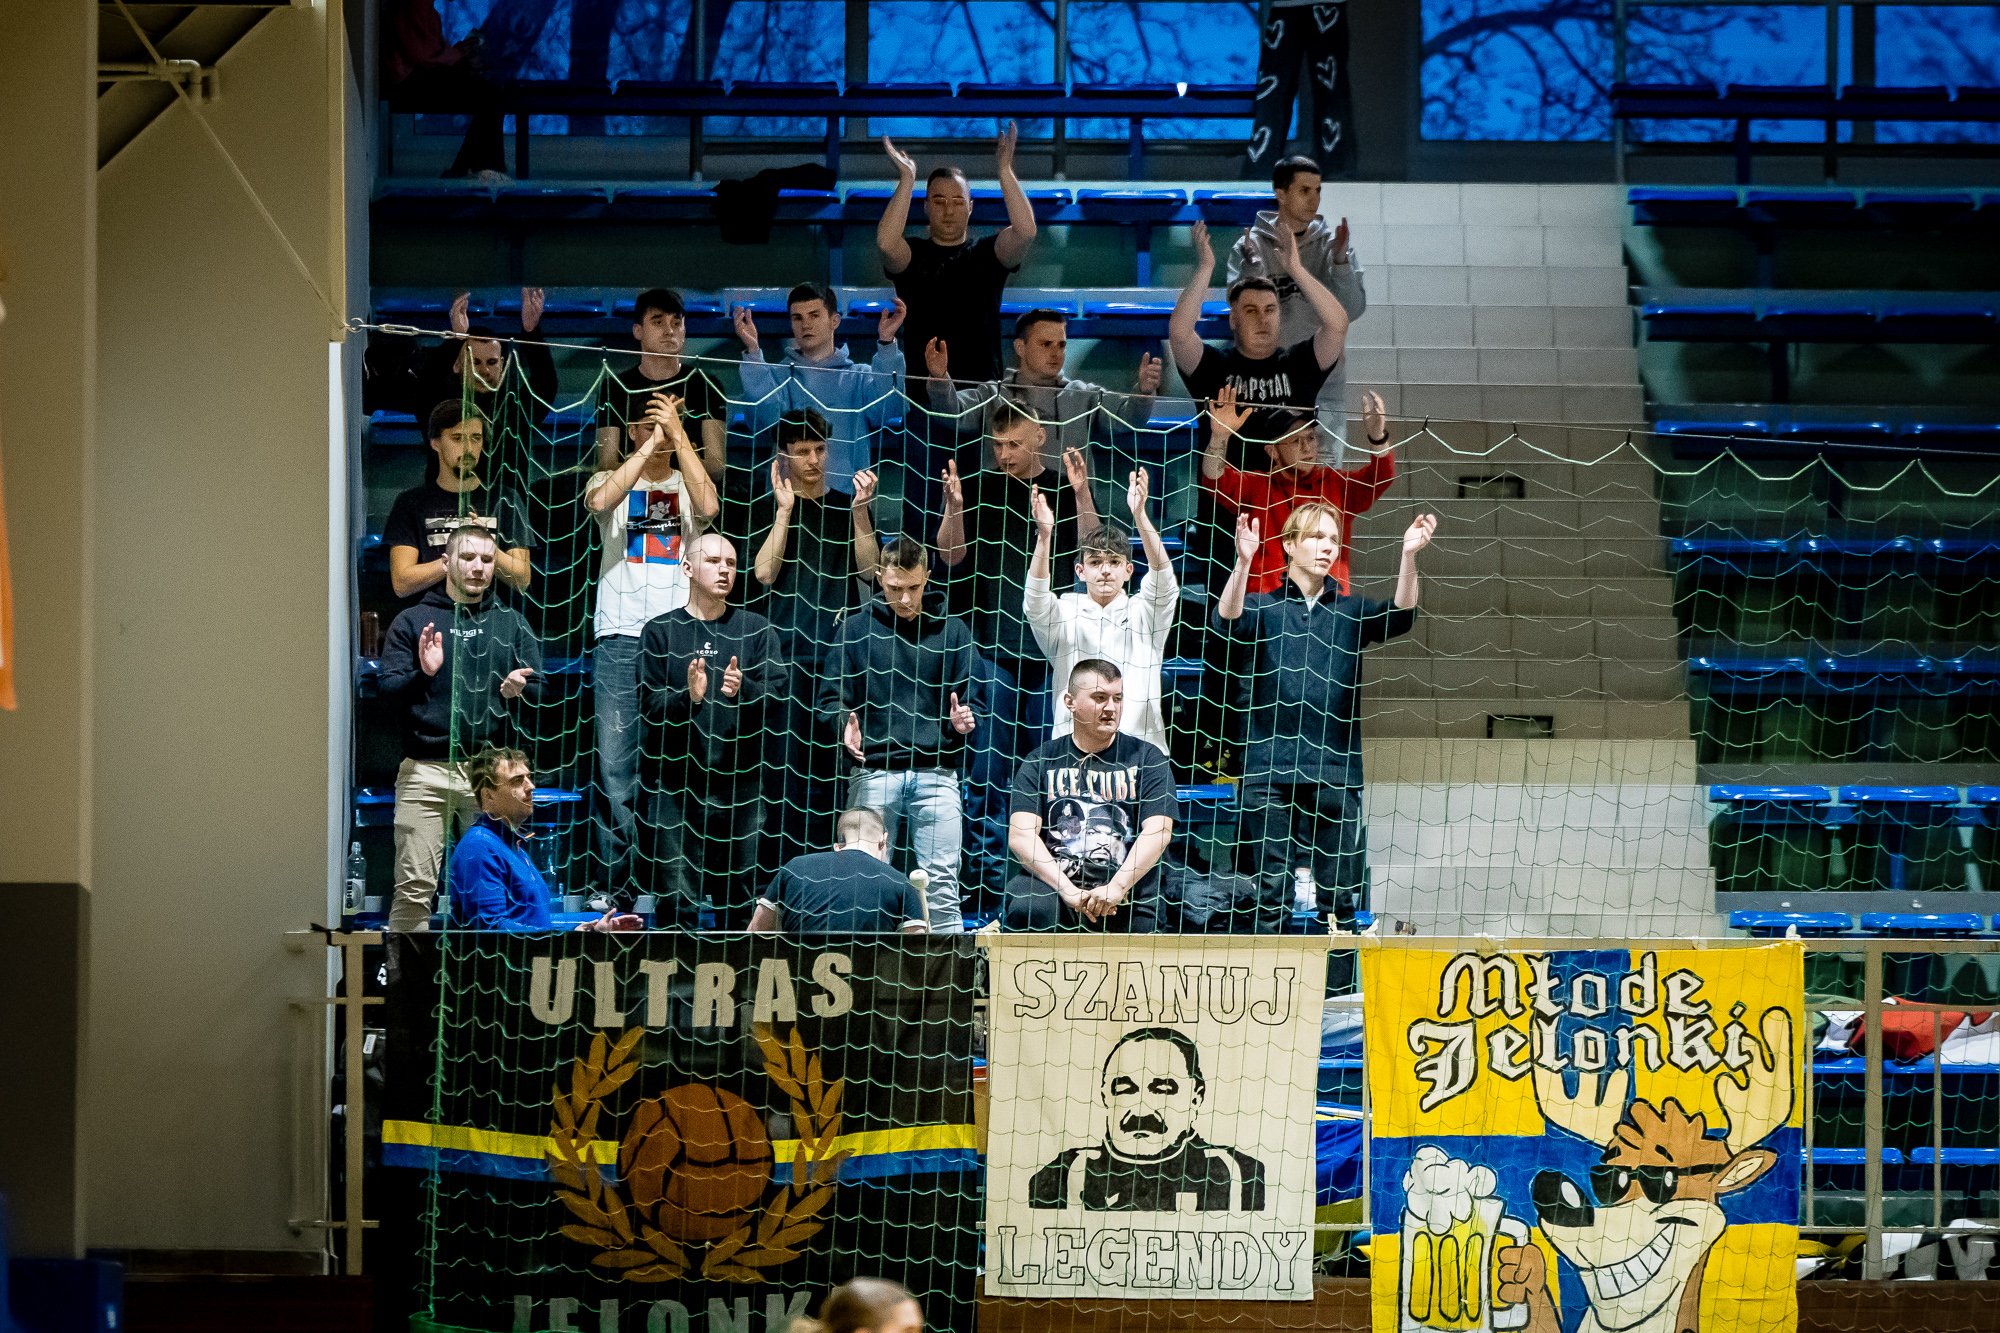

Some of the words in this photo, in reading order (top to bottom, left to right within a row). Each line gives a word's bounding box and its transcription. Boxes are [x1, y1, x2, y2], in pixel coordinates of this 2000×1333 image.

[1046, 767, 1081, 802] ICE
[529, 951, 855, 1028] ULTRAS
[1013, 959, 1296, 1026] SZANUJ
[1407, 1001, 1755, 1114] Jelonki
[997, 1225, 1307, 1291] LEGENDY
